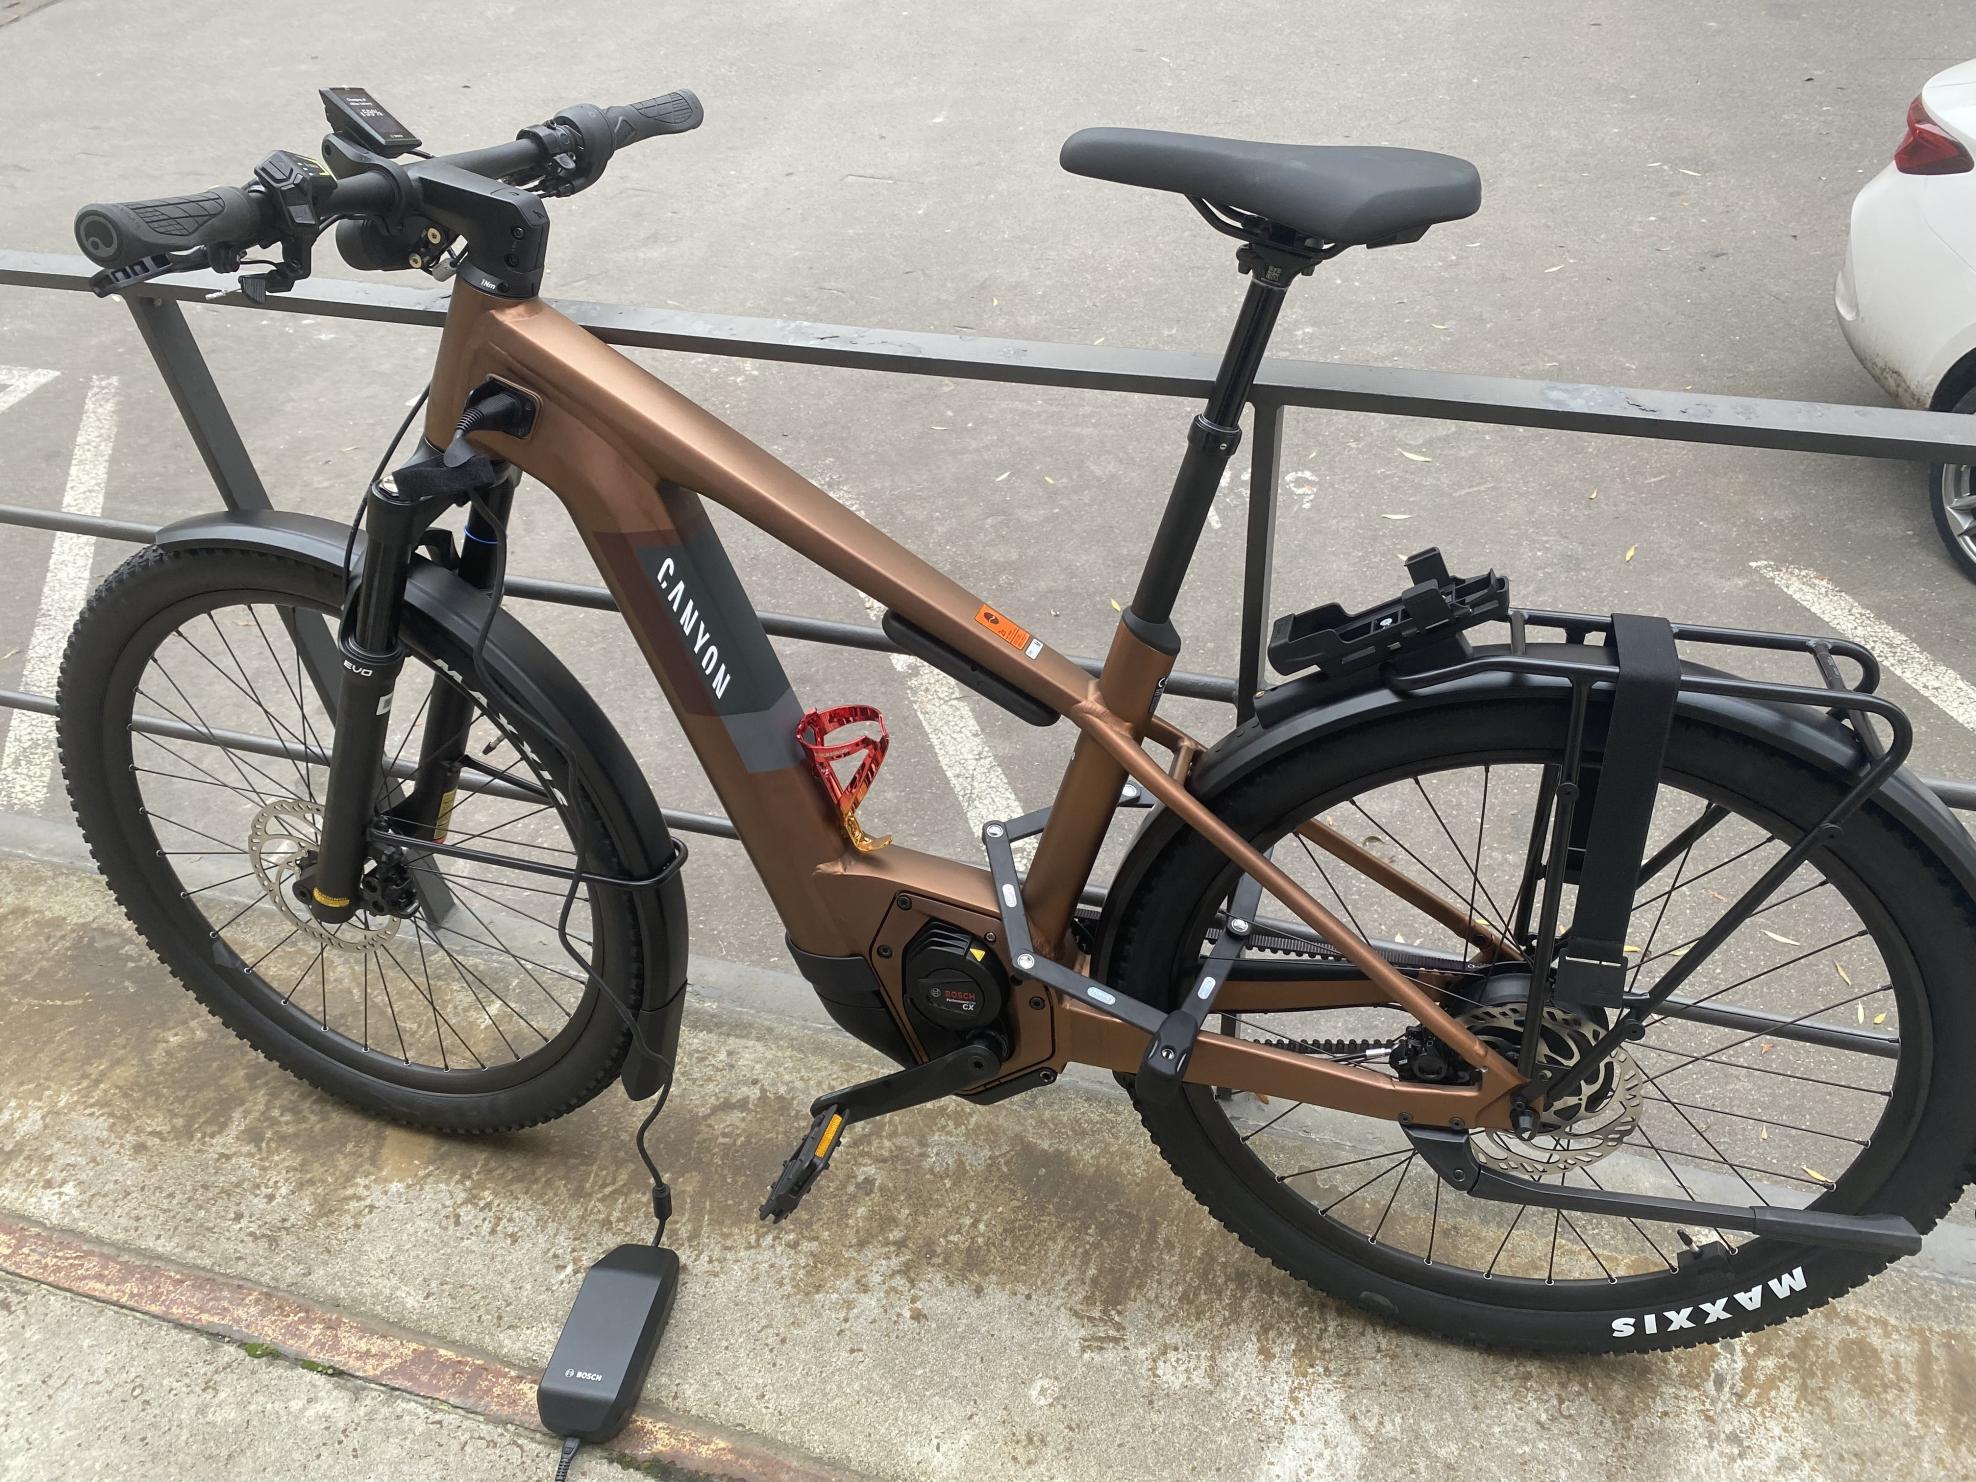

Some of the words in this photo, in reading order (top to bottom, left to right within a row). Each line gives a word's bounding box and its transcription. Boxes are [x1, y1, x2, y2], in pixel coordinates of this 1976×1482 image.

[481, 279, 496, 290] 1Nm
[657, 557, 731, 700] CANYON
[343, 659, 373, 677] EVO
[944, 990, 976, 1000] BOSCH
[962, 1003, 975, 1011] CX
[1611, 1266, 1808, 1338] MAXXIS
[576, 1371, 603, 1382] BOSCH
